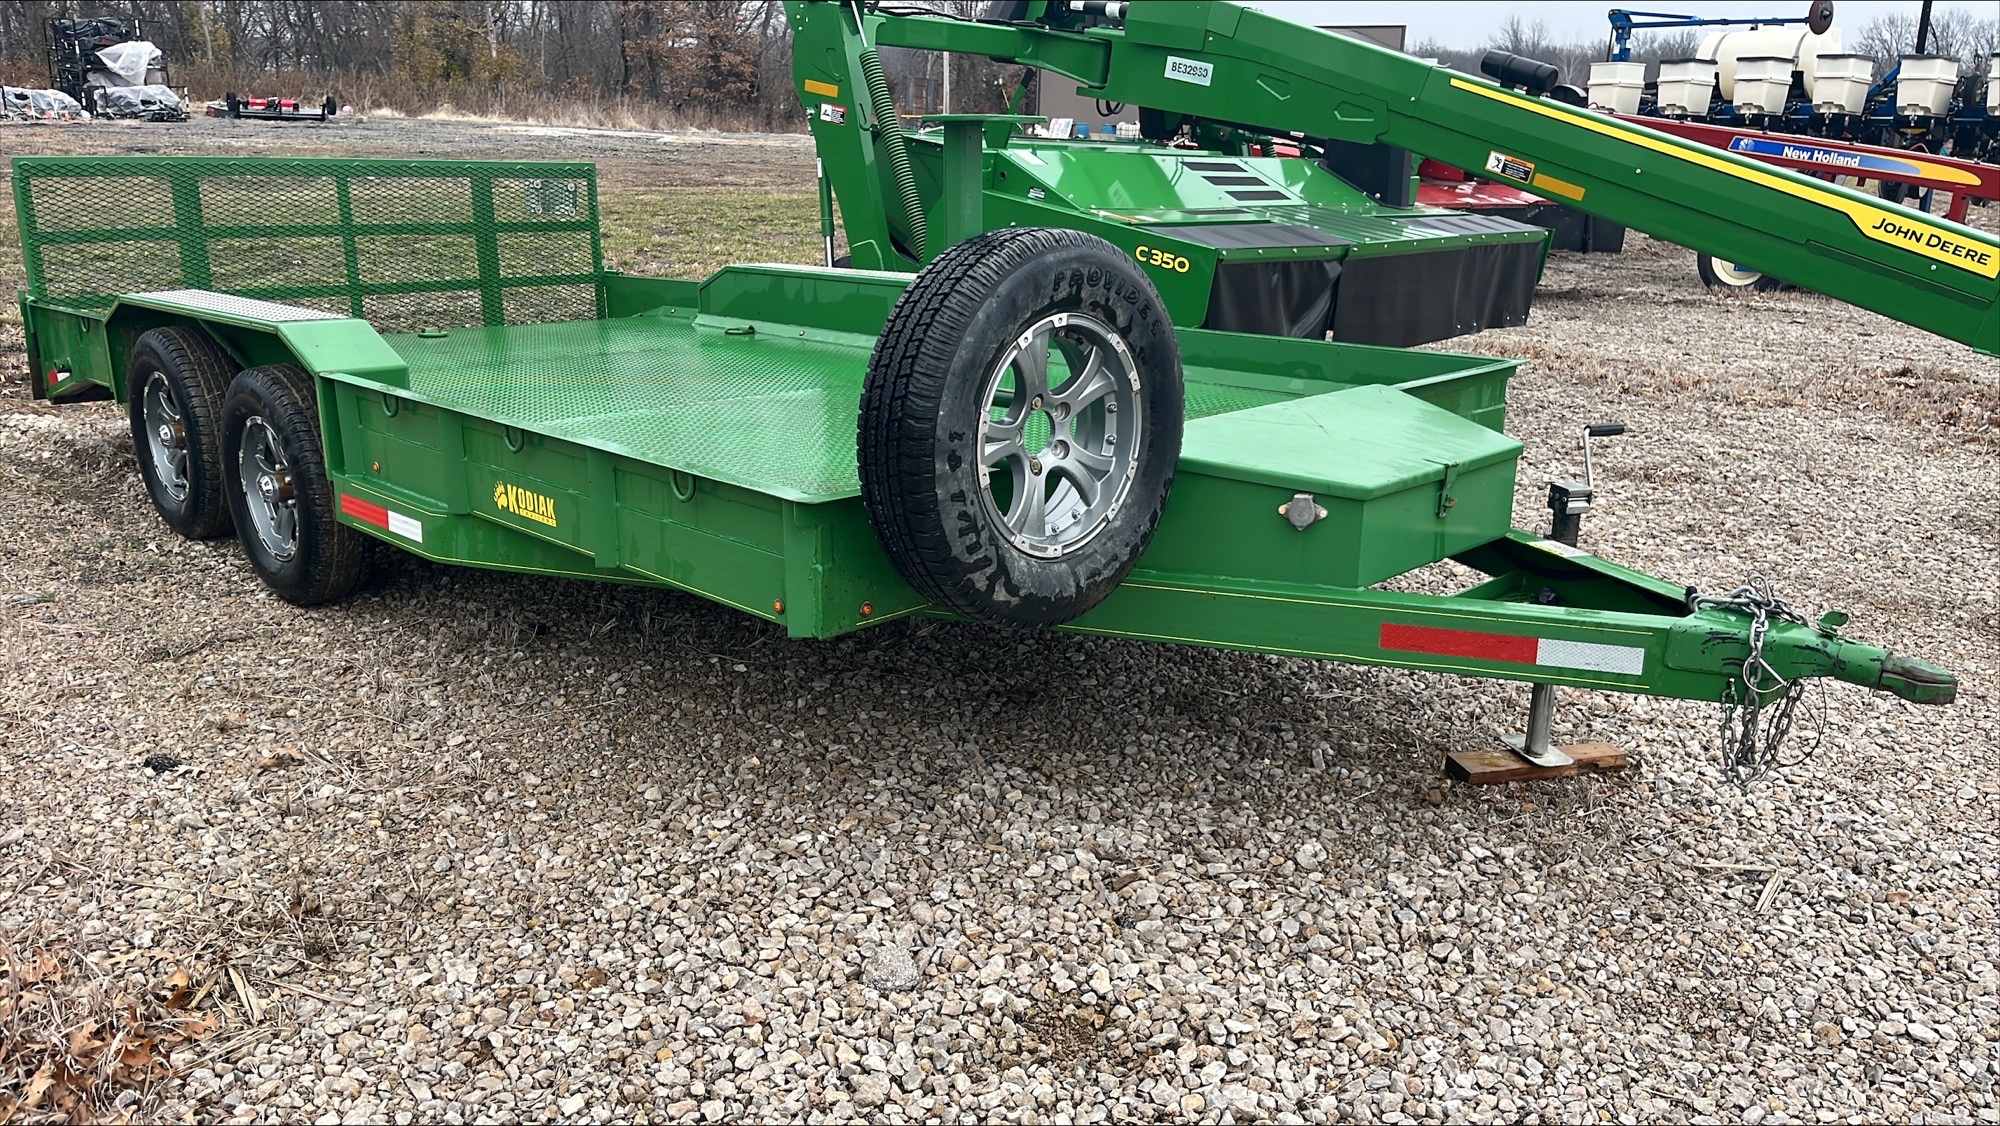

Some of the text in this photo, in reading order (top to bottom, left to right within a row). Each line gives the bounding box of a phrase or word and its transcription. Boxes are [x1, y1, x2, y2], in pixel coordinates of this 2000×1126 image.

[1782, 145, 1860, 167] New Holland
[1871, 217, 1992, 266] JOHN DEERE
[506, 483, 556, 520] KODIAK
